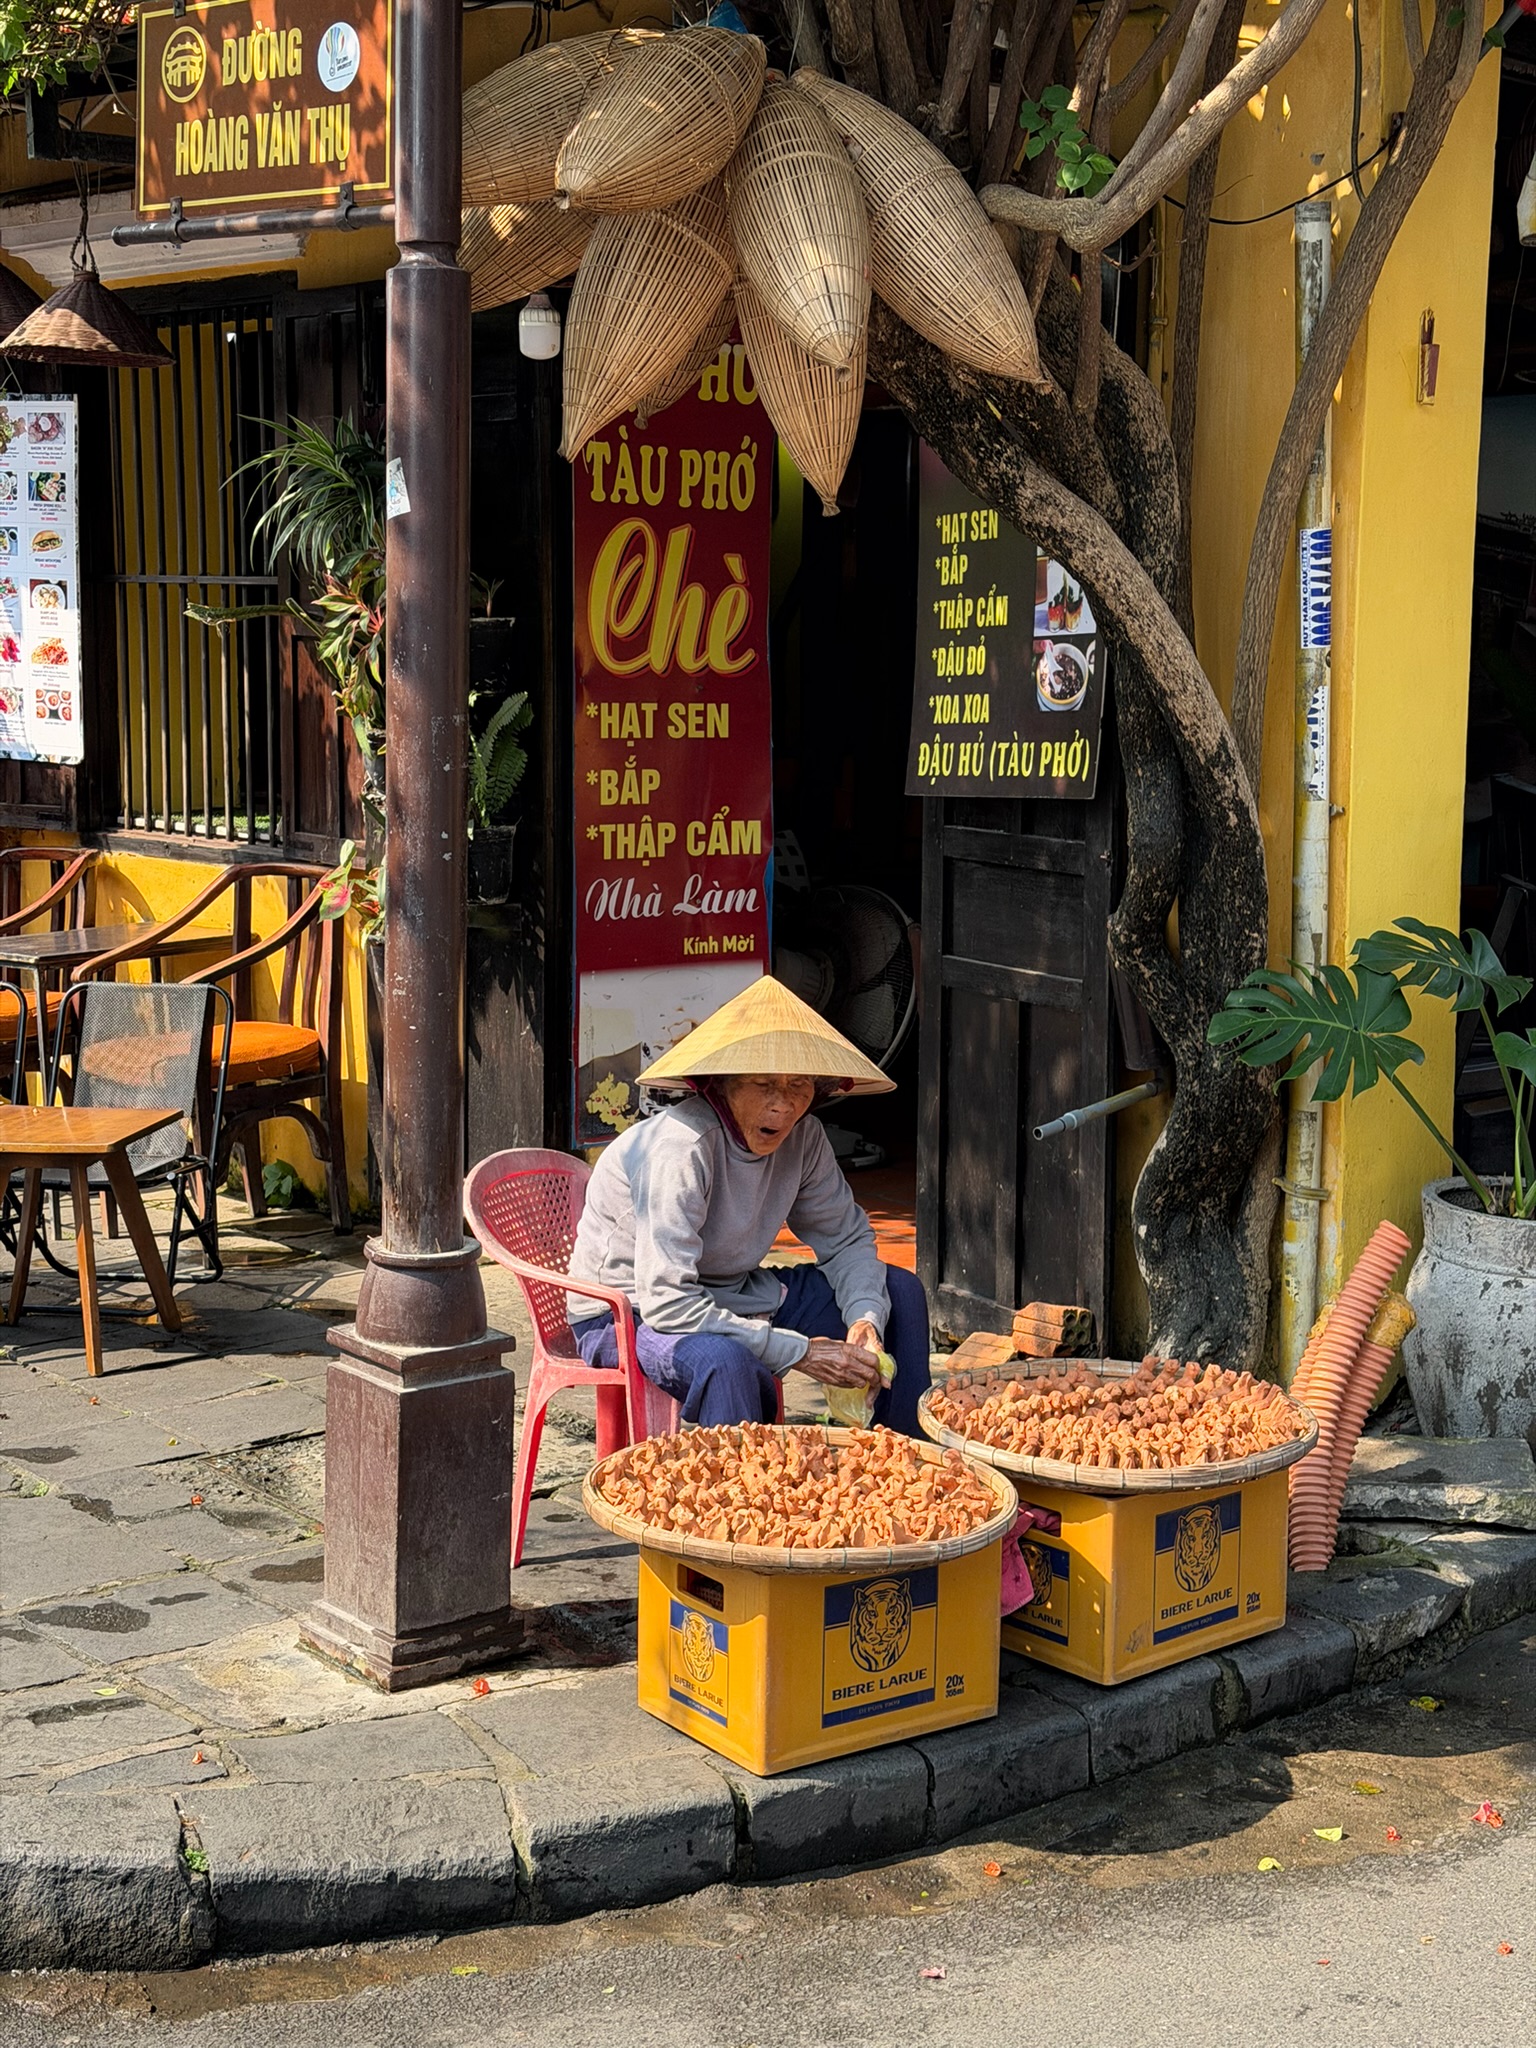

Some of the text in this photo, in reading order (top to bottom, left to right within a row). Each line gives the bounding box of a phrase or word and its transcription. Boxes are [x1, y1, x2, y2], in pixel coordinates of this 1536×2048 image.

[222, 21, 302, 86] ĐƯỜNG
[175, 101, 350, 176] HOÀNG VĂN THỤ
[586, 425, 668, 506] TÀU
[970, 509, 999, 542] SEN
[588, 517, 756, 677] Chè
[976, 584, 1008, 628] CẨM
[966, 635, 986, 676] ĐỎ
[667, 702, 729, 739] SEN
[962, 694, 990, 724] XOA
[917, 733, 954, 785] ĐẬU
[957, 731, 985, 777] HỦ
[989, 731, 1035, 782] (TÀU
[686, 806, 762, 857] CẨM
[585, 874, 760, 922] Nhà Làm
[684, 934, 755, 955] Kính Mời
[1031, 1610, 1063, 1628] LARUE
[1161, 1587, 1233, 1620] BIERE LARUE
[674, 1674, 696, 1692] BIERE
[698, 1687, 724, 1707] LARUE
[832, 1668, 928, 1701] BIERE LARUE
[945, 1674, 965, 1689] 20x
